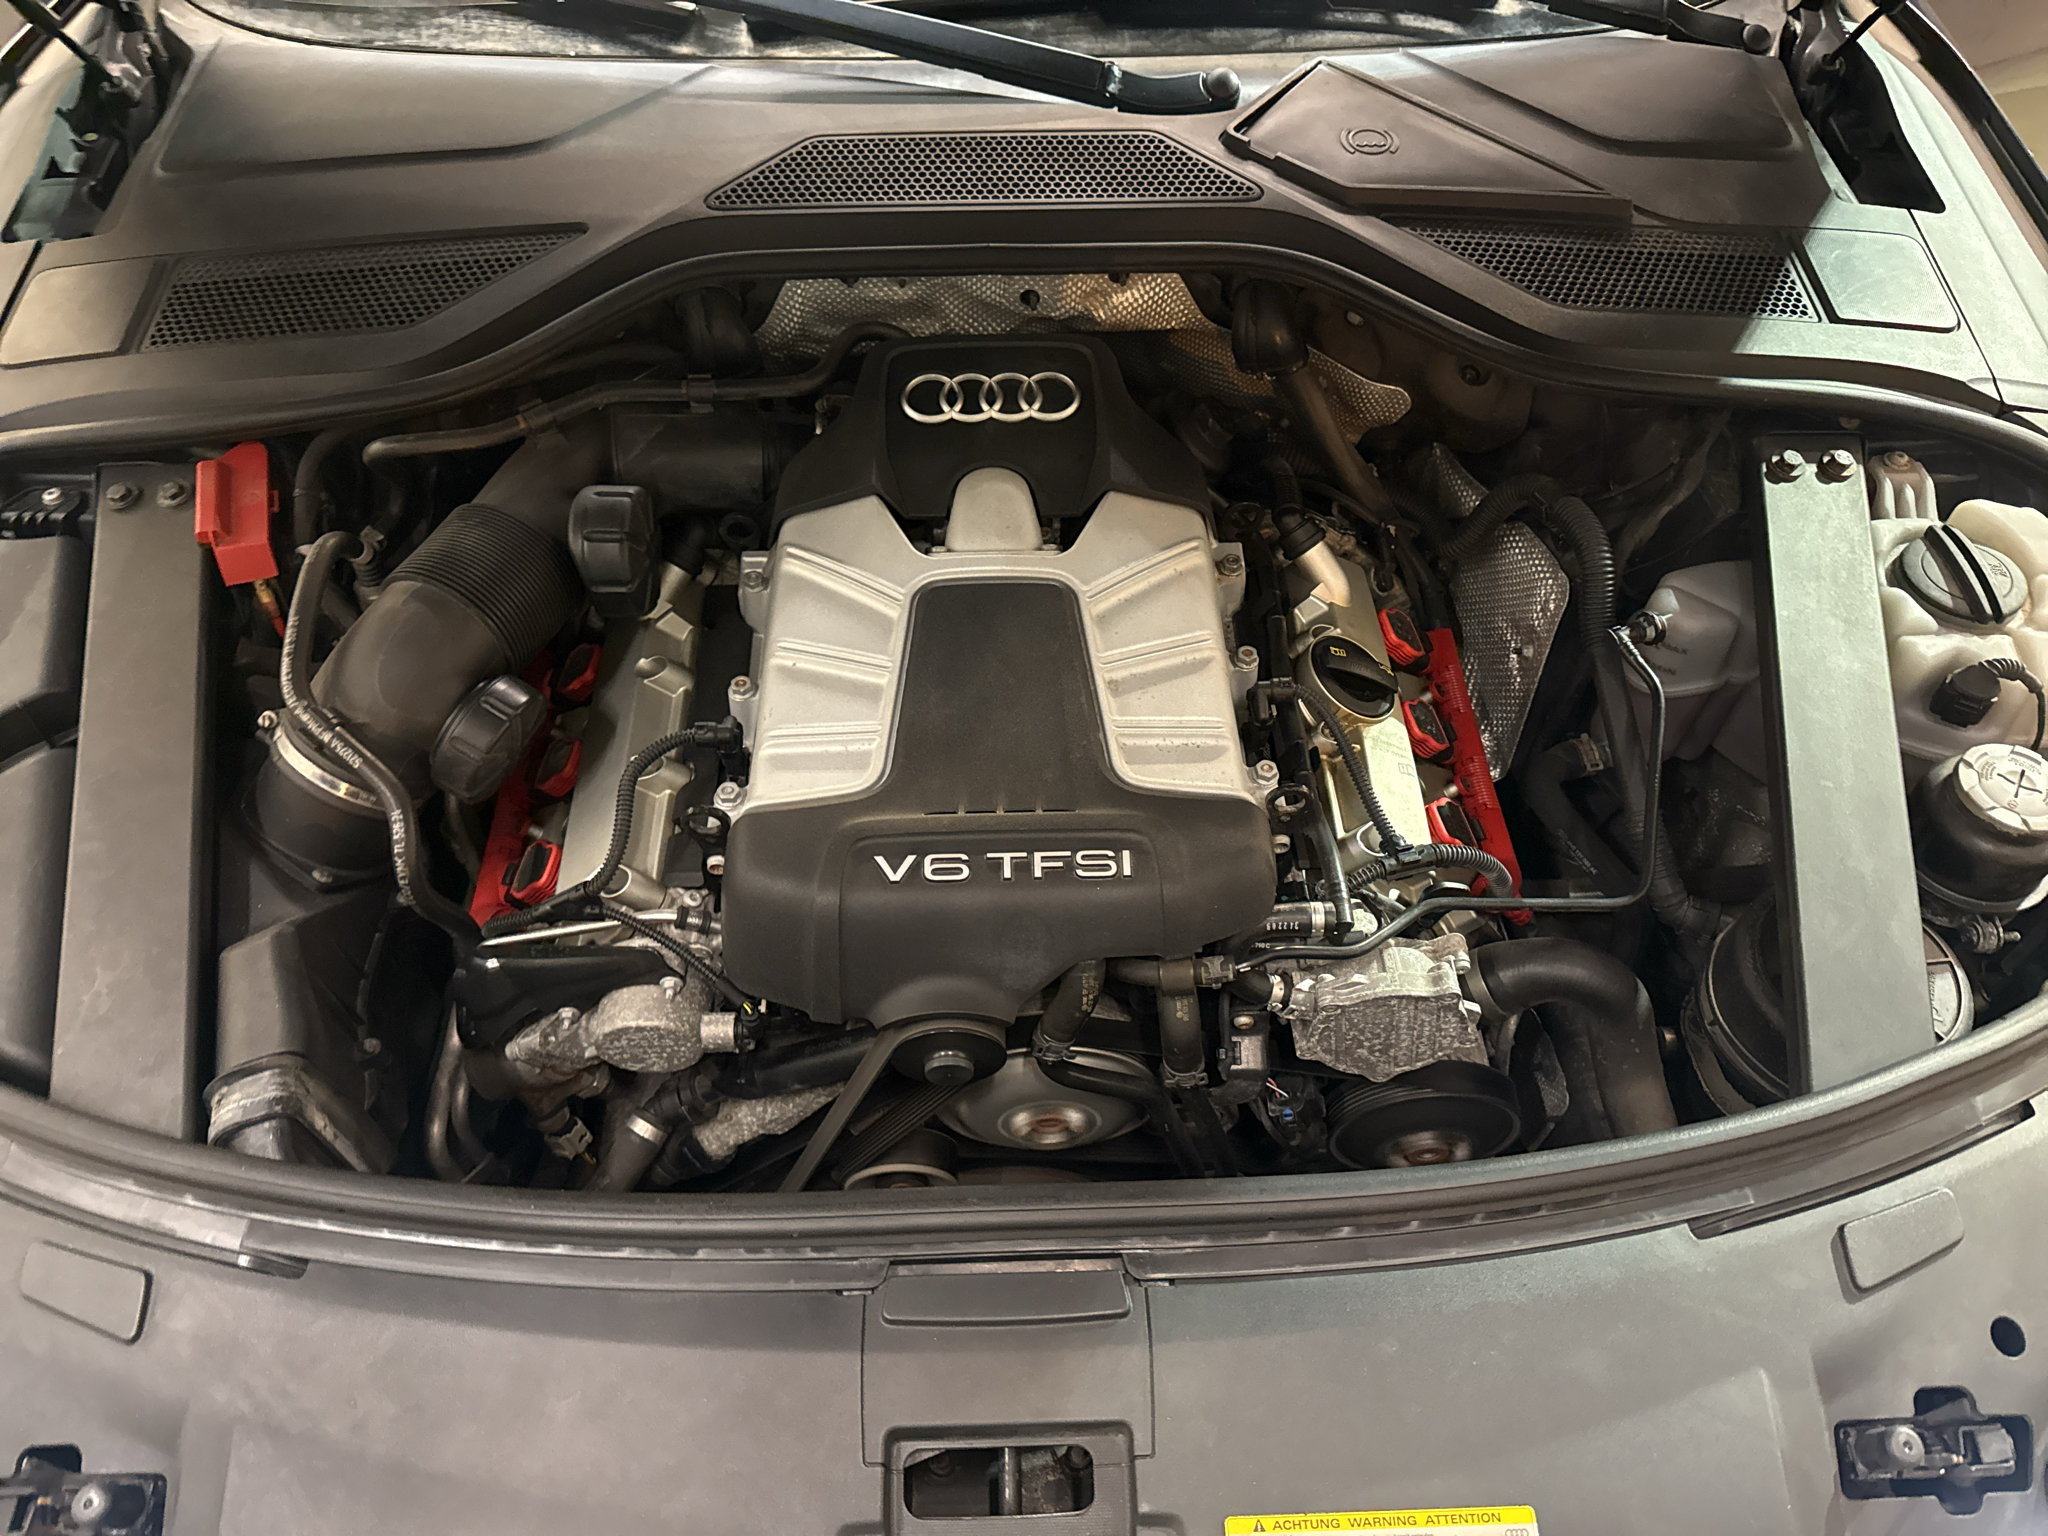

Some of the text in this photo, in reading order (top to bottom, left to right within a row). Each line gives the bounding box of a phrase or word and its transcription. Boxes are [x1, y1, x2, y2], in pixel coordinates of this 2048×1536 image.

[873, 850, 1133, 883] V6 TFSI
[1272, 1512, 1502, 1531] ACHTUNG WARNING ATTENTION
